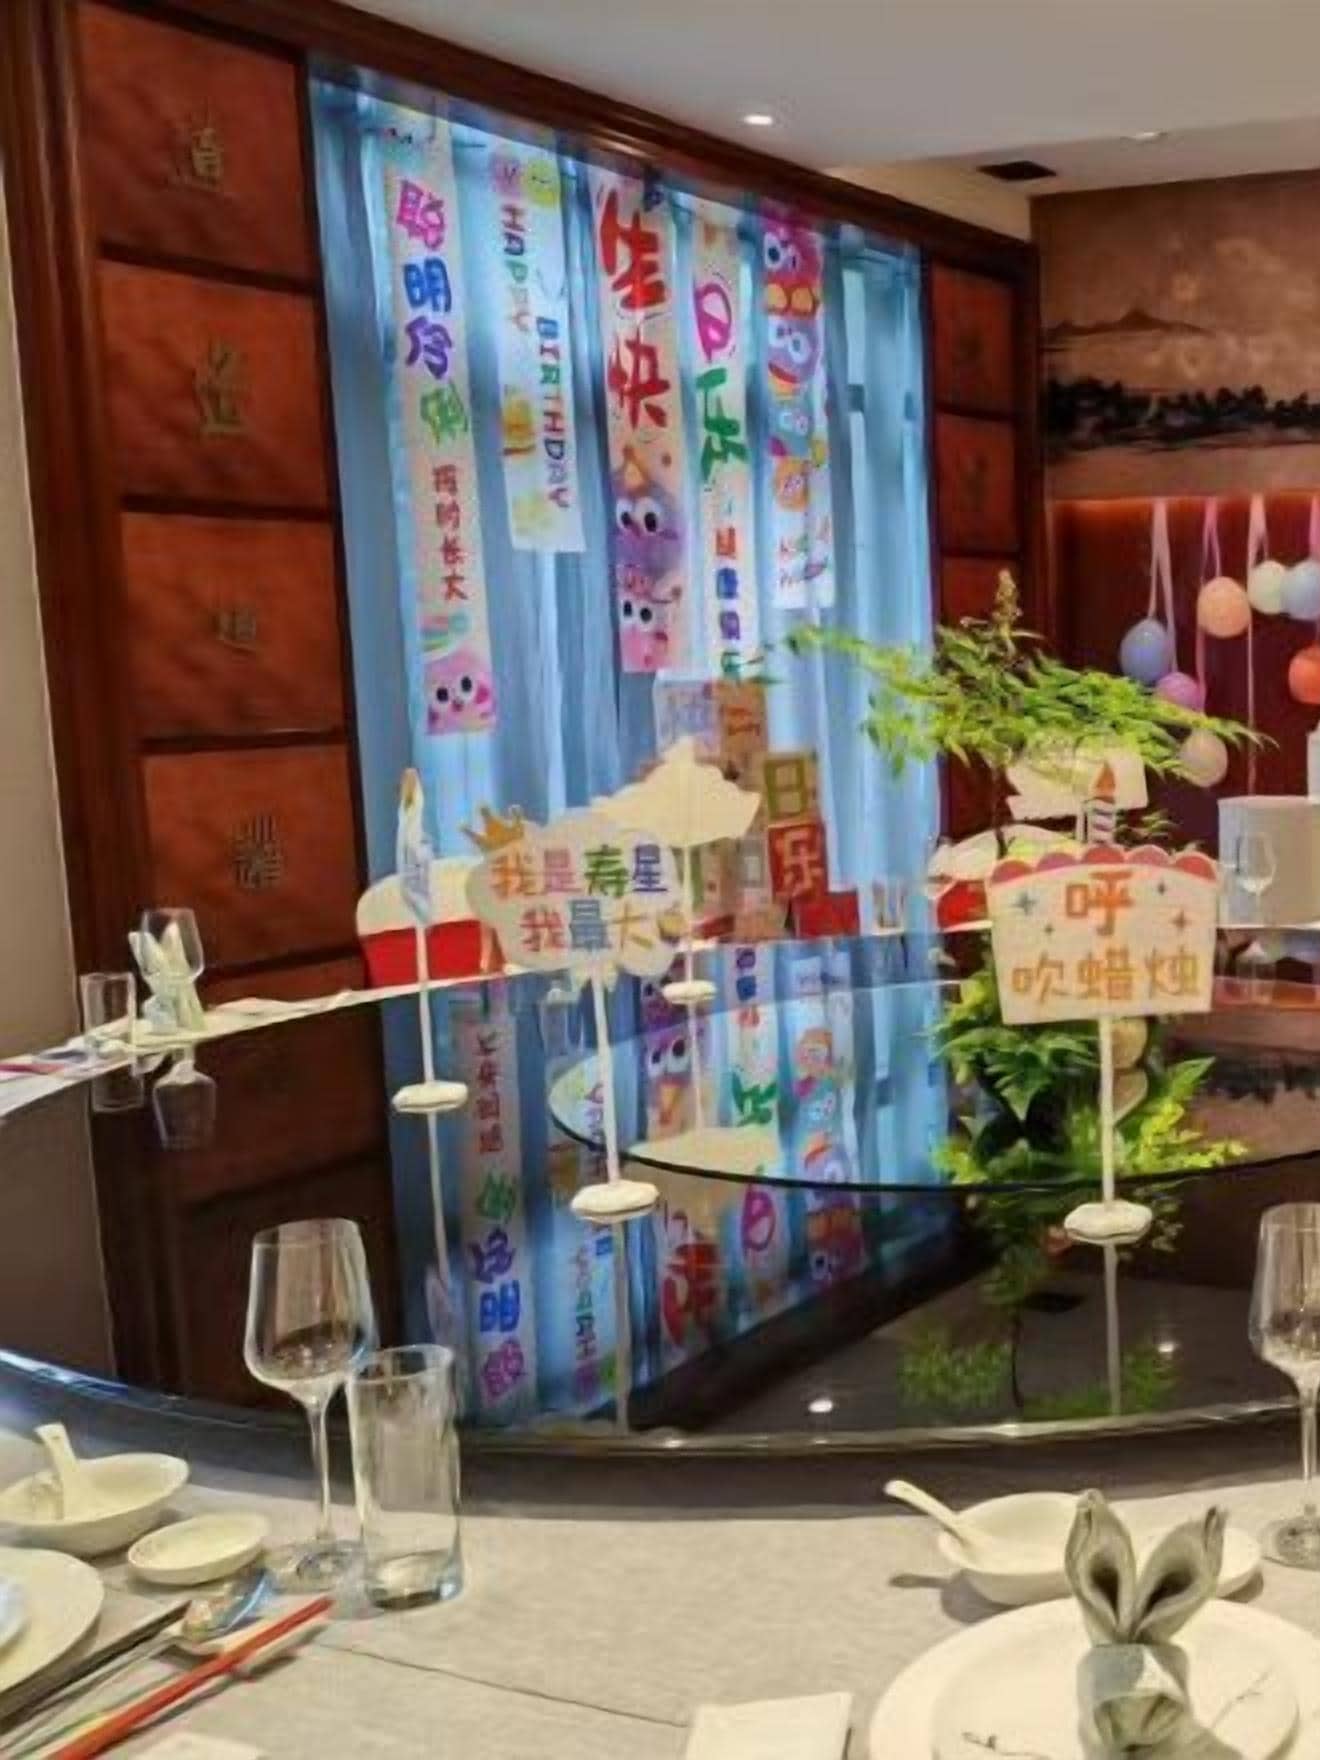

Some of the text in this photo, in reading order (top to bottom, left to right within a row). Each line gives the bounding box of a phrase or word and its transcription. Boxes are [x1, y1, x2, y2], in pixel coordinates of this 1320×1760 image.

[490, 843, 668, 900] 我是寿星
[519, 900, 654, 952] 我最大
[1065, 870, 1136, 937] 呼
[1011, 944, 1199, 1004] 吹蜡烛
